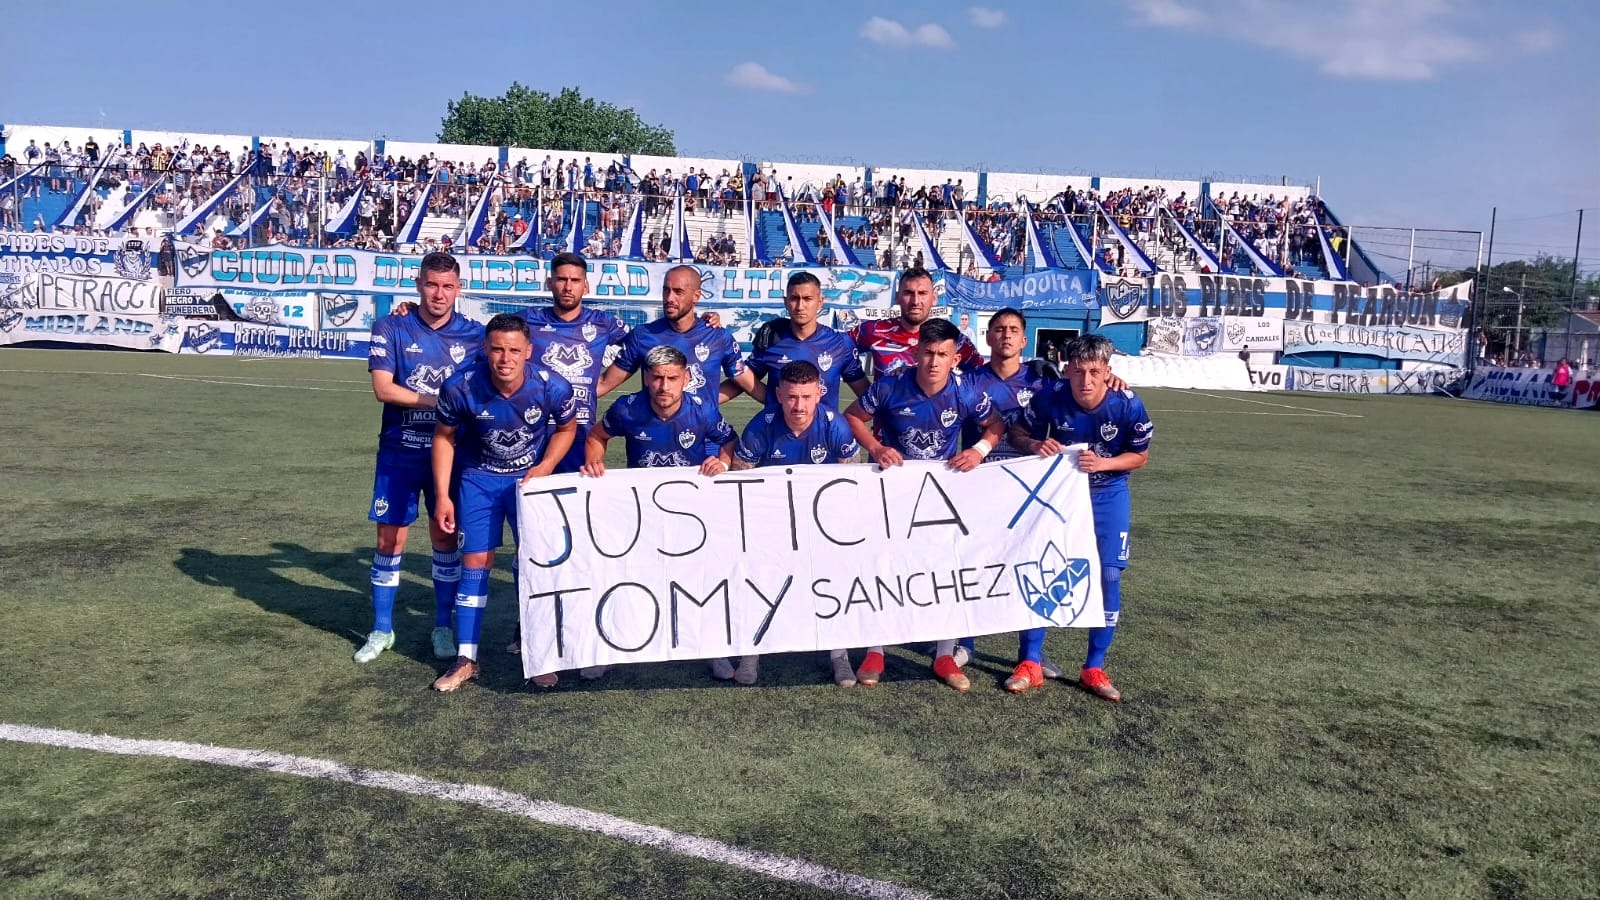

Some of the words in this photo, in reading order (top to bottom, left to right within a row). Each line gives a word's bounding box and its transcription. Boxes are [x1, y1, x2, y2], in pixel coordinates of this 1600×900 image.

[75, 237, 110, 256] DE
[2, 255, 102, 274] TRAPOS
[211, 249, 357, 284] CIUDAD
[722, 269, 810, 299] LT1
[41, 273, 158, 311] PETRACCI
[973, 275, 1083, 299] BLANQUITA
[165, 296, 193, 305] NEGRO
[195, 296, 201, 304] Y
[166, 305, 215, 315] FUNEBRERO
[283, 304, 305, 318] 12
[1147, 274, 1187, 318] LOS
[1200, 275, 1265, 318] PIBES
[1285, 279, 1314, 320] DE
[1331, 284, 1438, 327] PEARSON
[865, 308, 878, 318] QUE
[24, 314, 154, 335] MIDLAND
[1333, 325, 1446, 354] LIBERTAD
[1000, 453, 1066, 531] X
[528, 574, 793, 659] TOMY
[809, 562, 1011, 620] SANCHEZ
